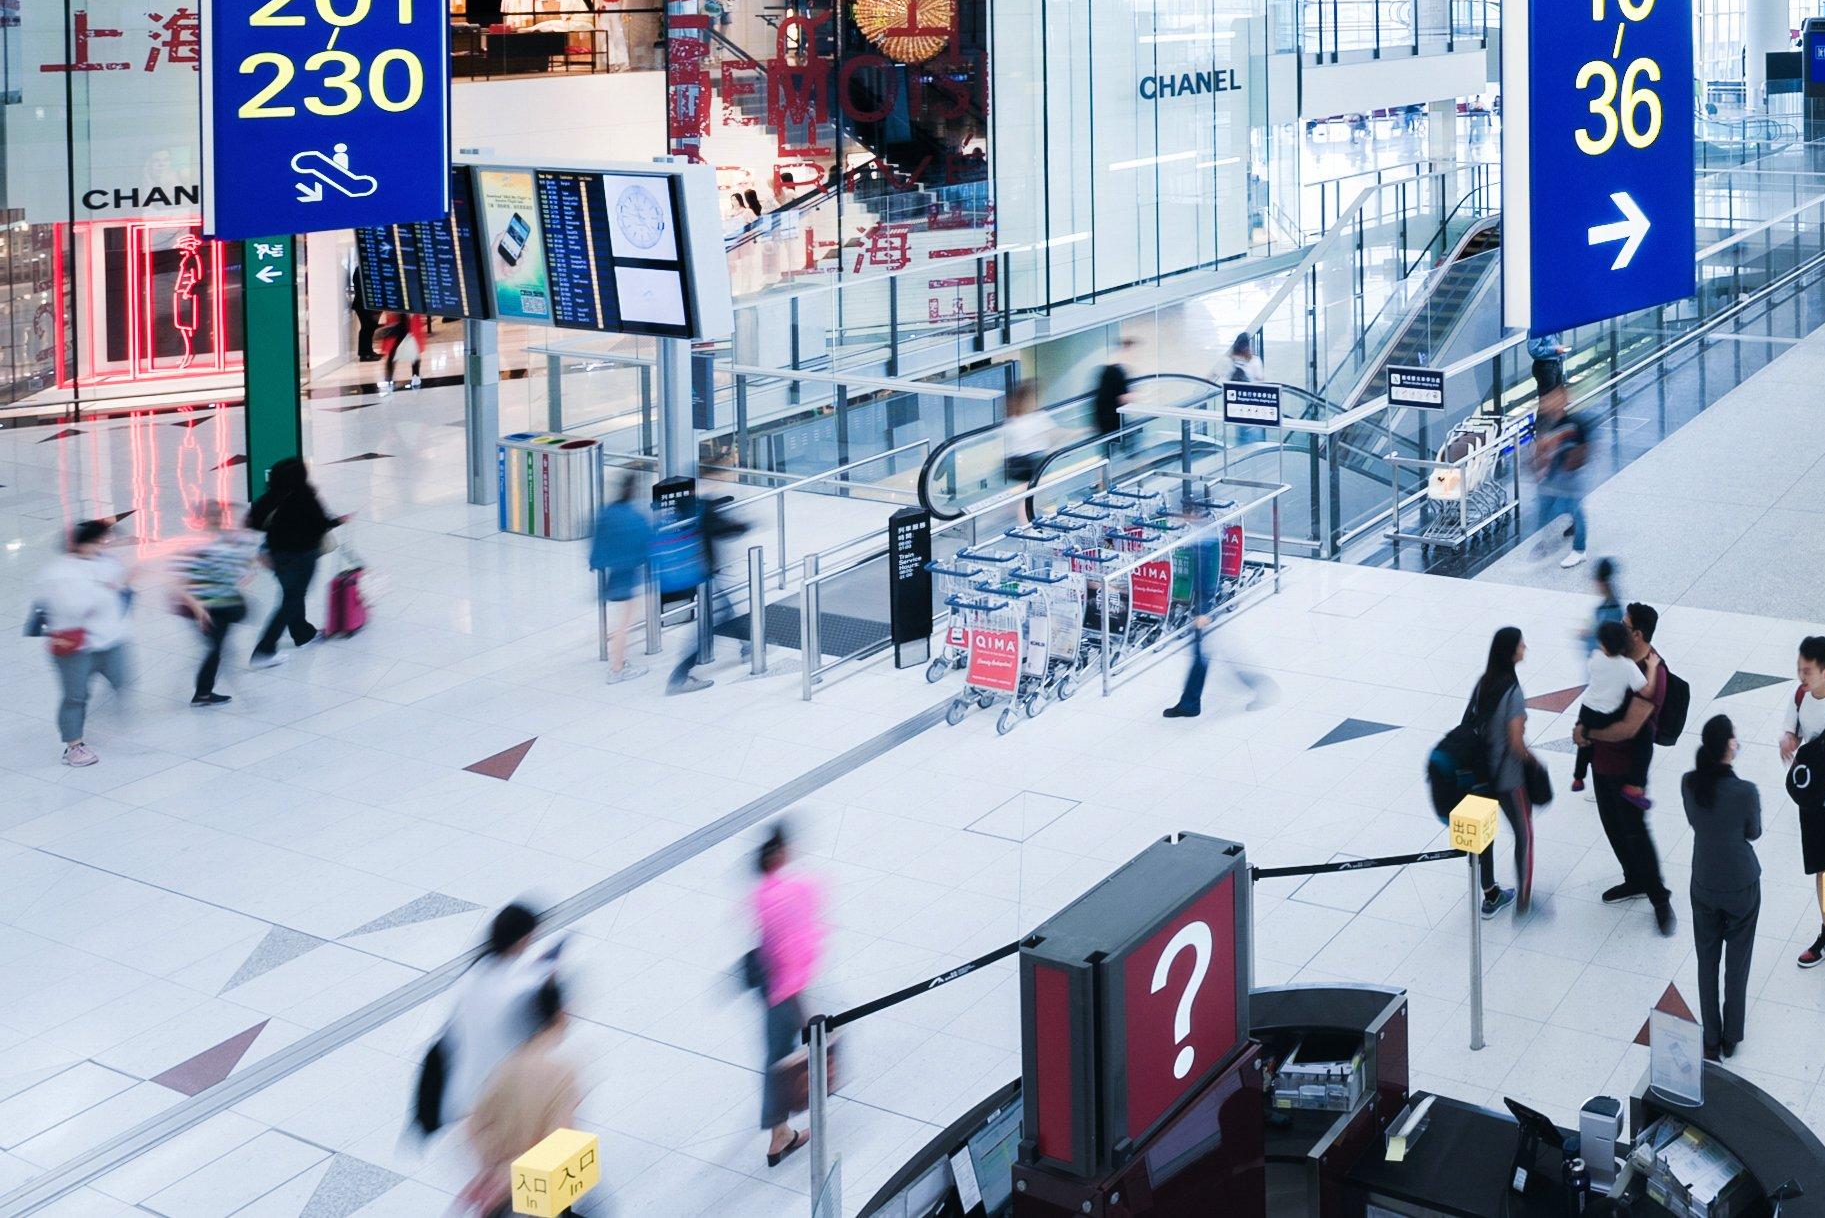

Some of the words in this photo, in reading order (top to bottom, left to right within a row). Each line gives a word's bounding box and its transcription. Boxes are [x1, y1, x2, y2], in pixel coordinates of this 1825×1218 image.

[238, 49, 424, 119] 230
[1140, 69, 1242, 100] CHANEL
[1575, 58, 1662, 156] 36
[899, 552, 914, 560] Train
[899, 556, 922, 566] Service
[1131, 566, 1168, 581] QIMA
[975, 635, 1016, 653] QIMA
[1453, 819, 1477, 835] 出口
[1455, 835, 1473, 847] Out
[558, 1149, 595, 1190] 入口
[517, 1173, 547, 1194] 入口
[570, 1180, 584, 1196] In
[526, 1195, 538, 1209] In
